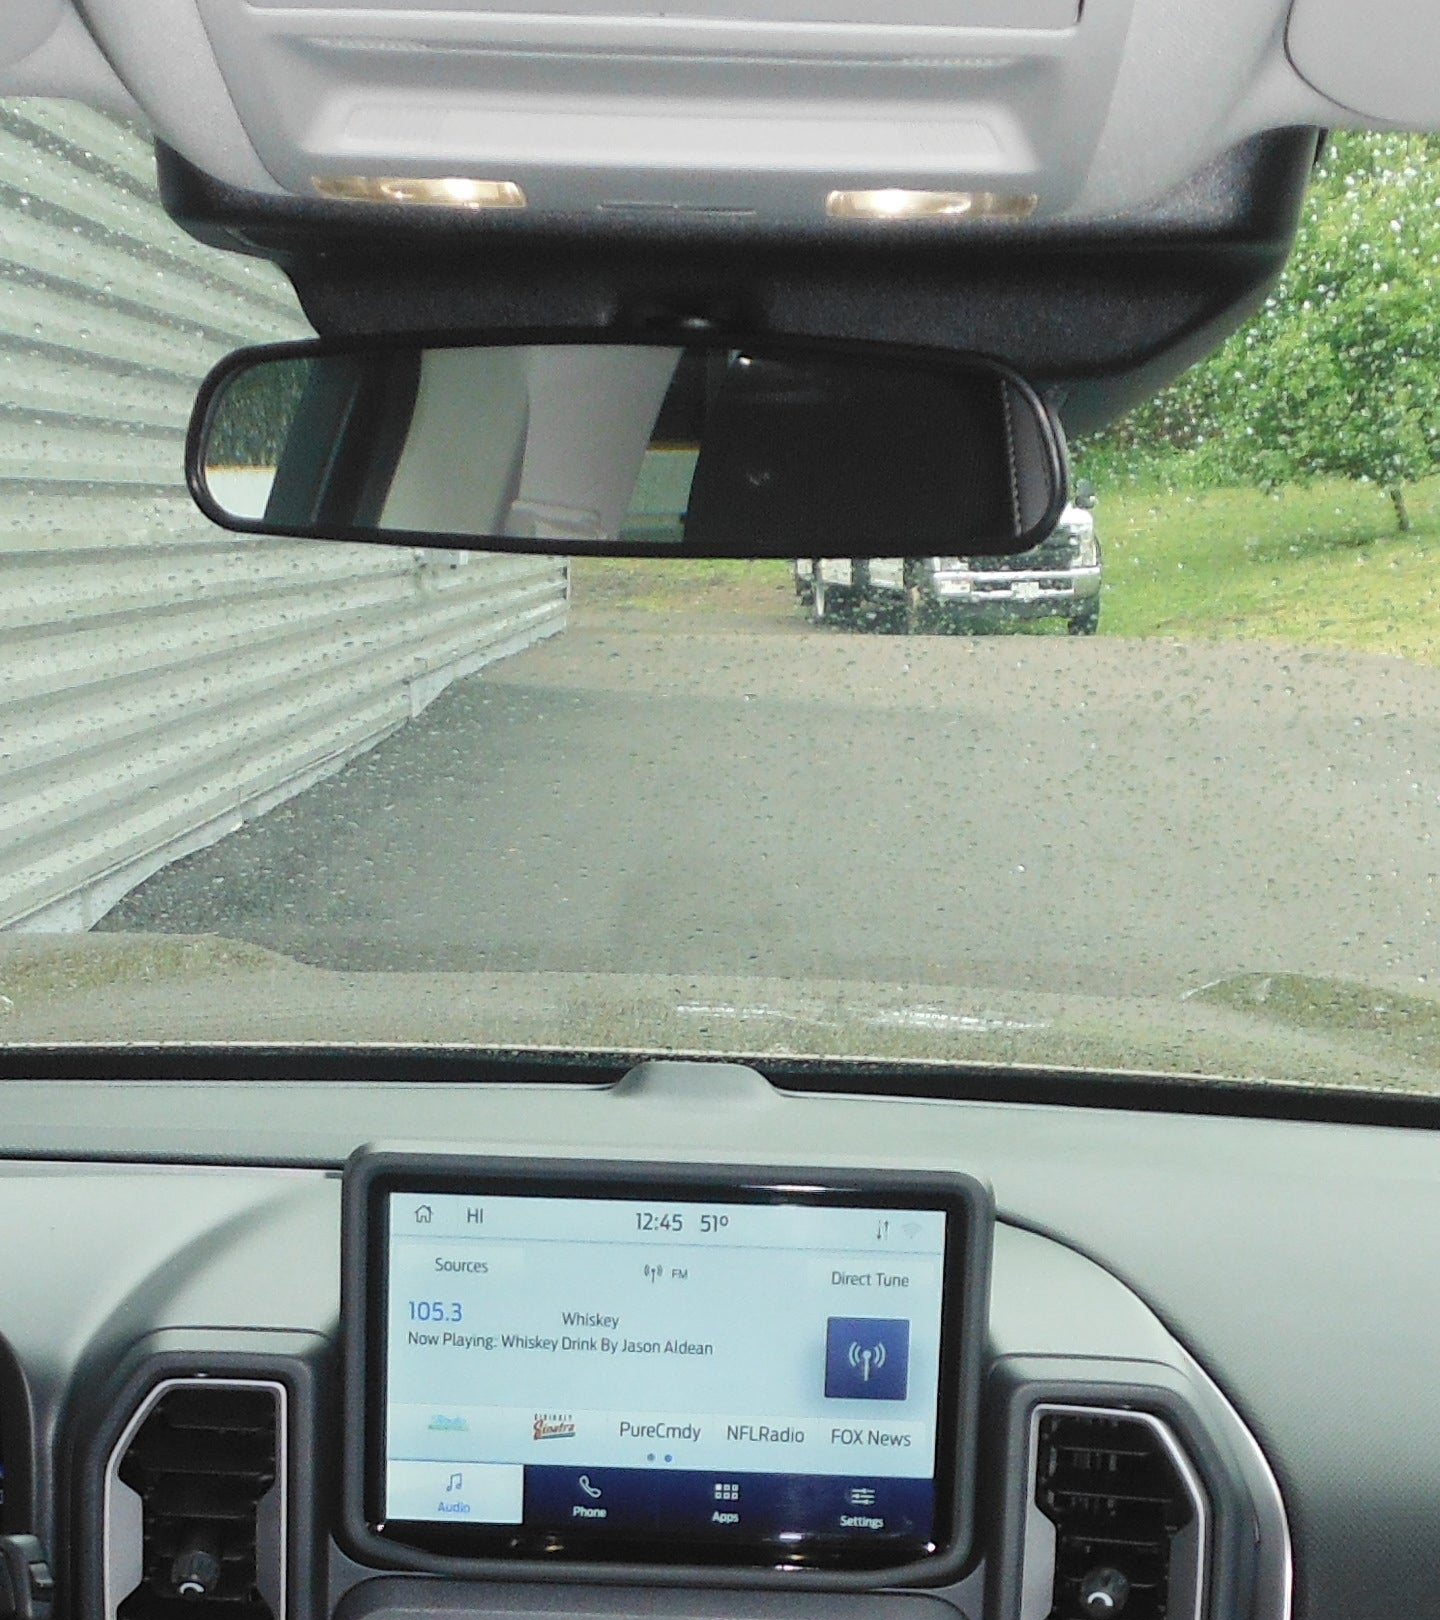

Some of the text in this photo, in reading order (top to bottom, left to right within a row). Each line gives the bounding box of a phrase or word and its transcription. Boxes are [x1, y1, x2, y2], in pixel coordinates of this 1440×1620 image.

[466, 1207, 484, 1224] HI
[635, 1212, 683, 1232] 12:45
[434, 1257, 489, 1274] Sources
[671, 1268, 688, 1280] FM
[831, 1270, 910, 1288] Direct Tune
[408, 1301, 462, 1322] 105.3
[561, 1311, 620, 1330] Whiskey
[408, 1331, 439, 1346] Now
[501, 1334, 558, 1352] Whiskey
[561, 1337, 597, 1351] Drink
[601, 1338, 618, 1354] By
[622, 1338, 661, 1354] Jason
[664, 1338, 713, 1355] Aldean
[619, 1421, 702, 1442] PureCmdy
[726, 1424, 805, 1443] NFLRadio
[831, 1428, 912, 1448] FOX News
[437, 1501, 471, 1514] Audio
[572, 1506, 607, 1519] Phone
[712, 1511, 739, 1524] Apps
[839, 1515, 884, 1530] Settings
